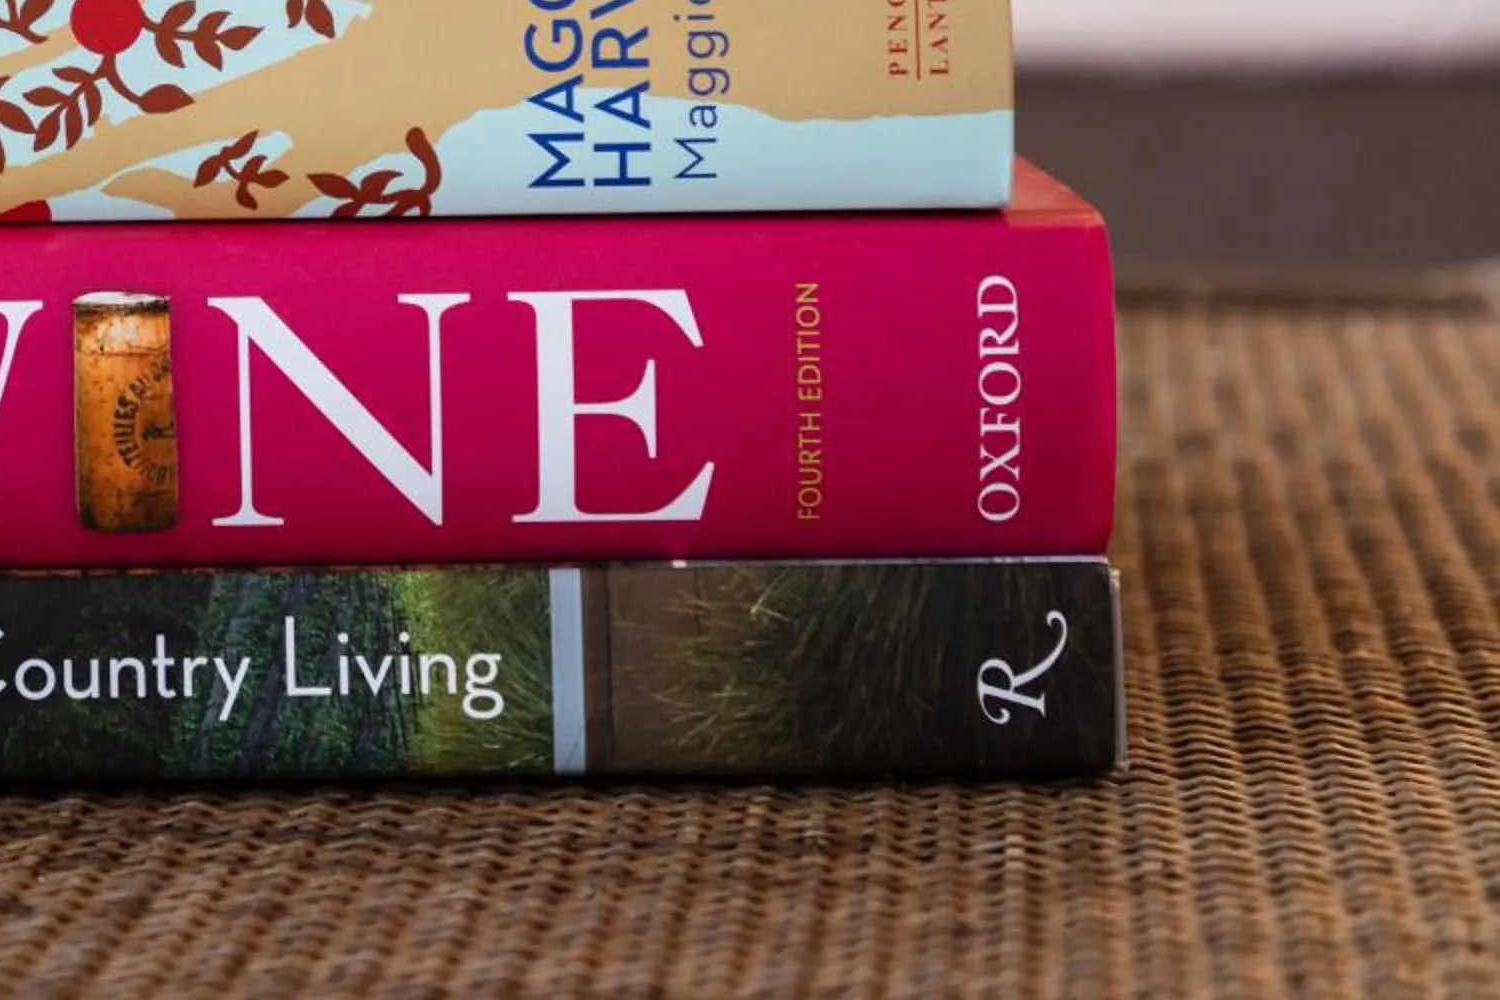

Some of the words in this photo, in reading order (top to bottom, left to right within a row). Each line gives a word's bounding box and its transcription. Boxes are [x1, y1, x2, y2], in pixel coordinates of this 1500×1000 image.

[795, 282, 821, 400] EDITION
[976, 274, 1021, 522] OXFORD
[795, 411, 822, 521] FOURTH
[285, 615, 504, 720] Living
